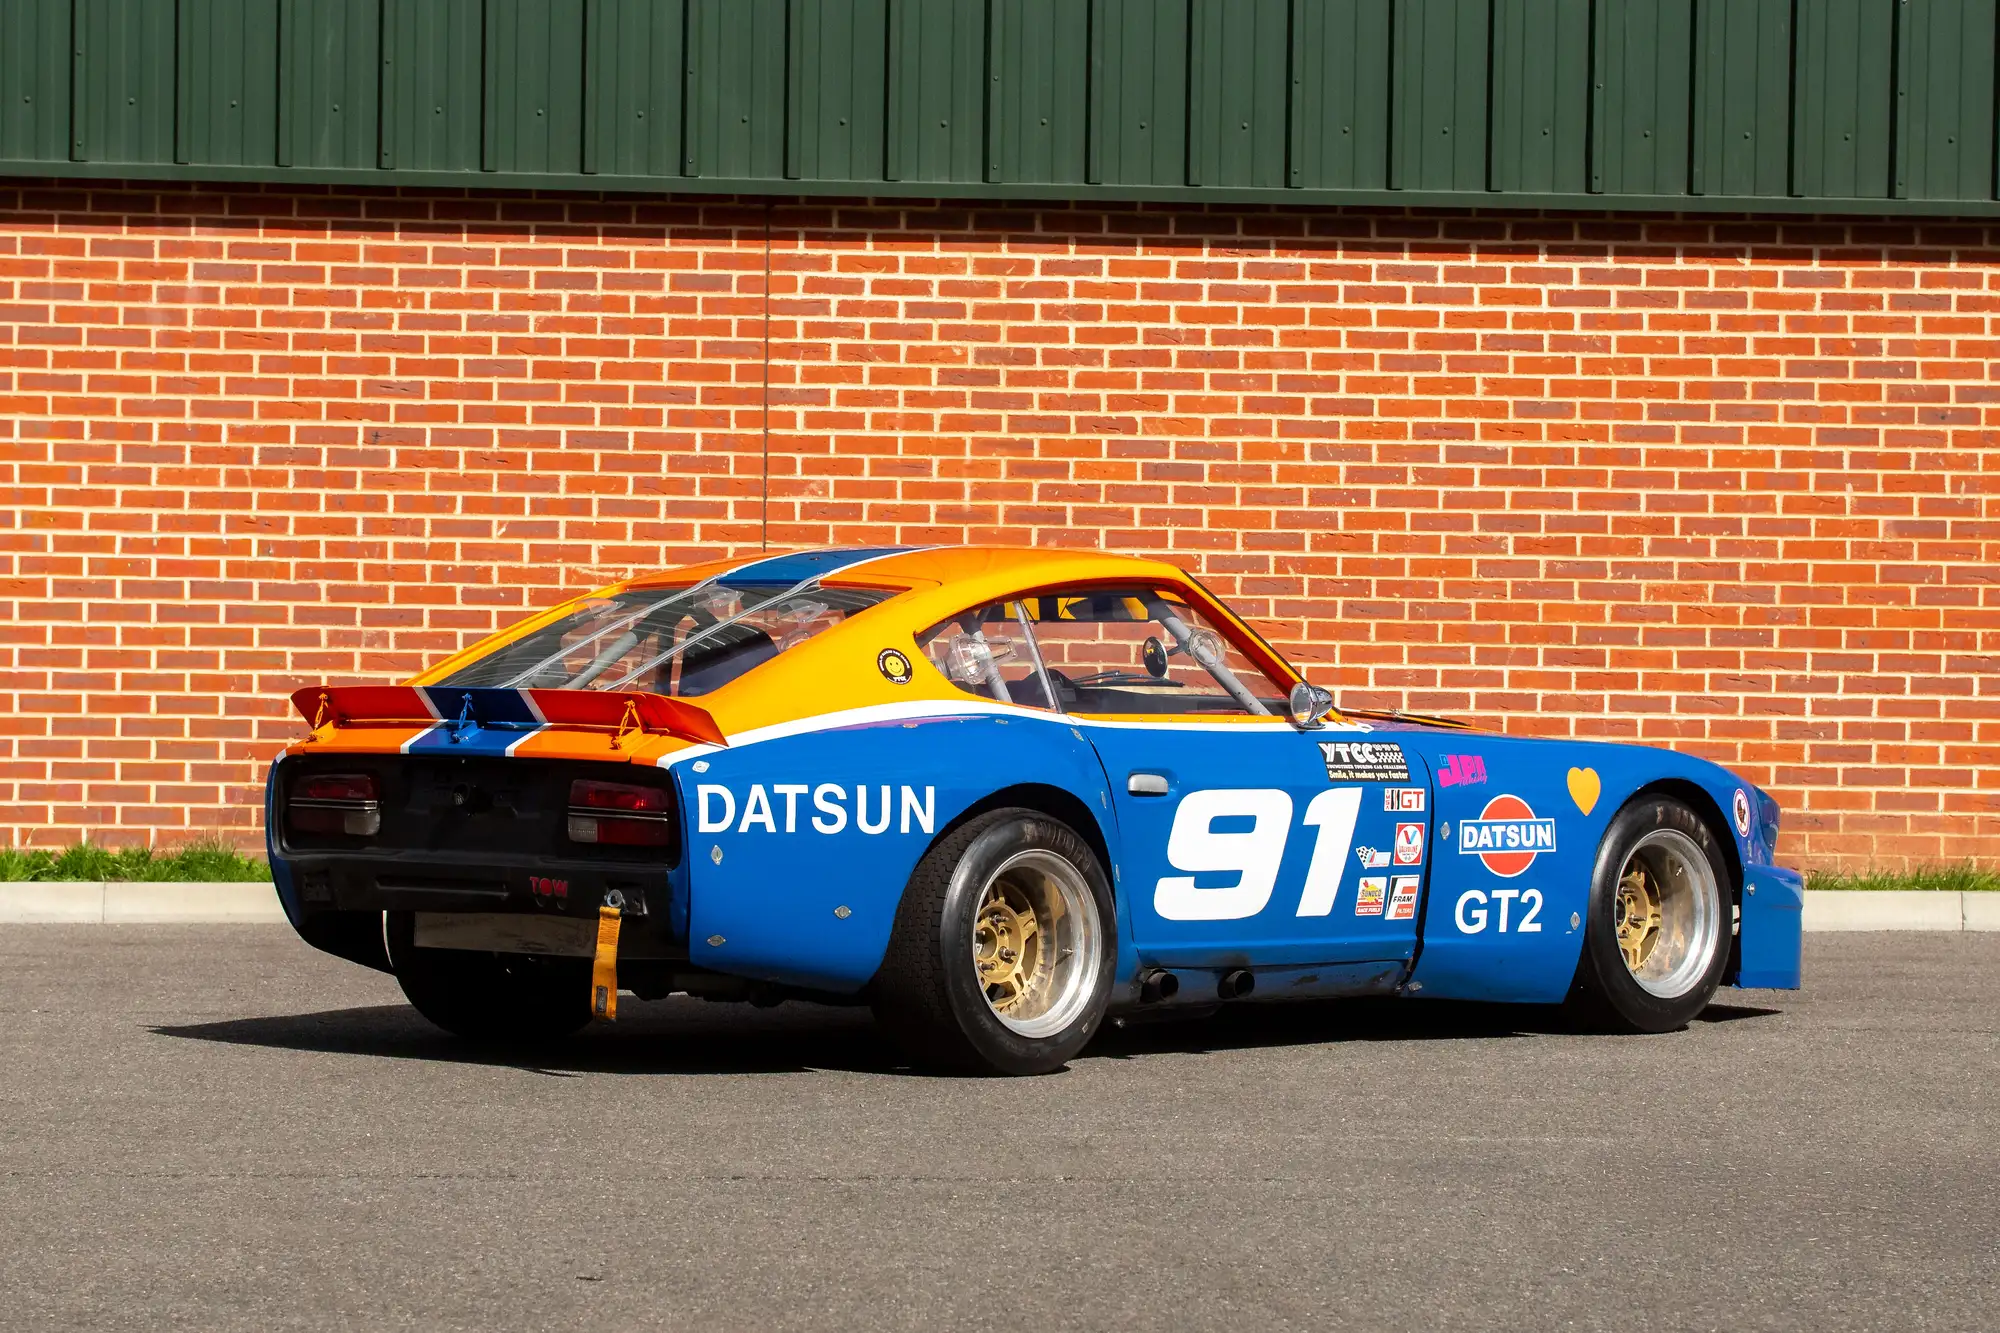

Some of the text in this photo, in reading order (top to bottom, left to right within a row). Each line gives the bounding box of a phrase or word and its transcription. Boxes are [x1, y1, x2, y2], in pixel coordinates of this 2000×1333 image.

[1318, 743, 1378, 763] YTCC
[1328, 770, 1408, 780] Smile, it makes you faster
[697, 783, 935, 835] DATSUN
[1401, 791, 1424, 808] GT
[1463, 824, 1551, 848] DATSUN
[1153, 787, 1363, 920] 91
[529, 876, 568, 898] TOW
[1362, 889, 1382, 897] SUNOCO
[1455, 889, 1543, 934] GT2
